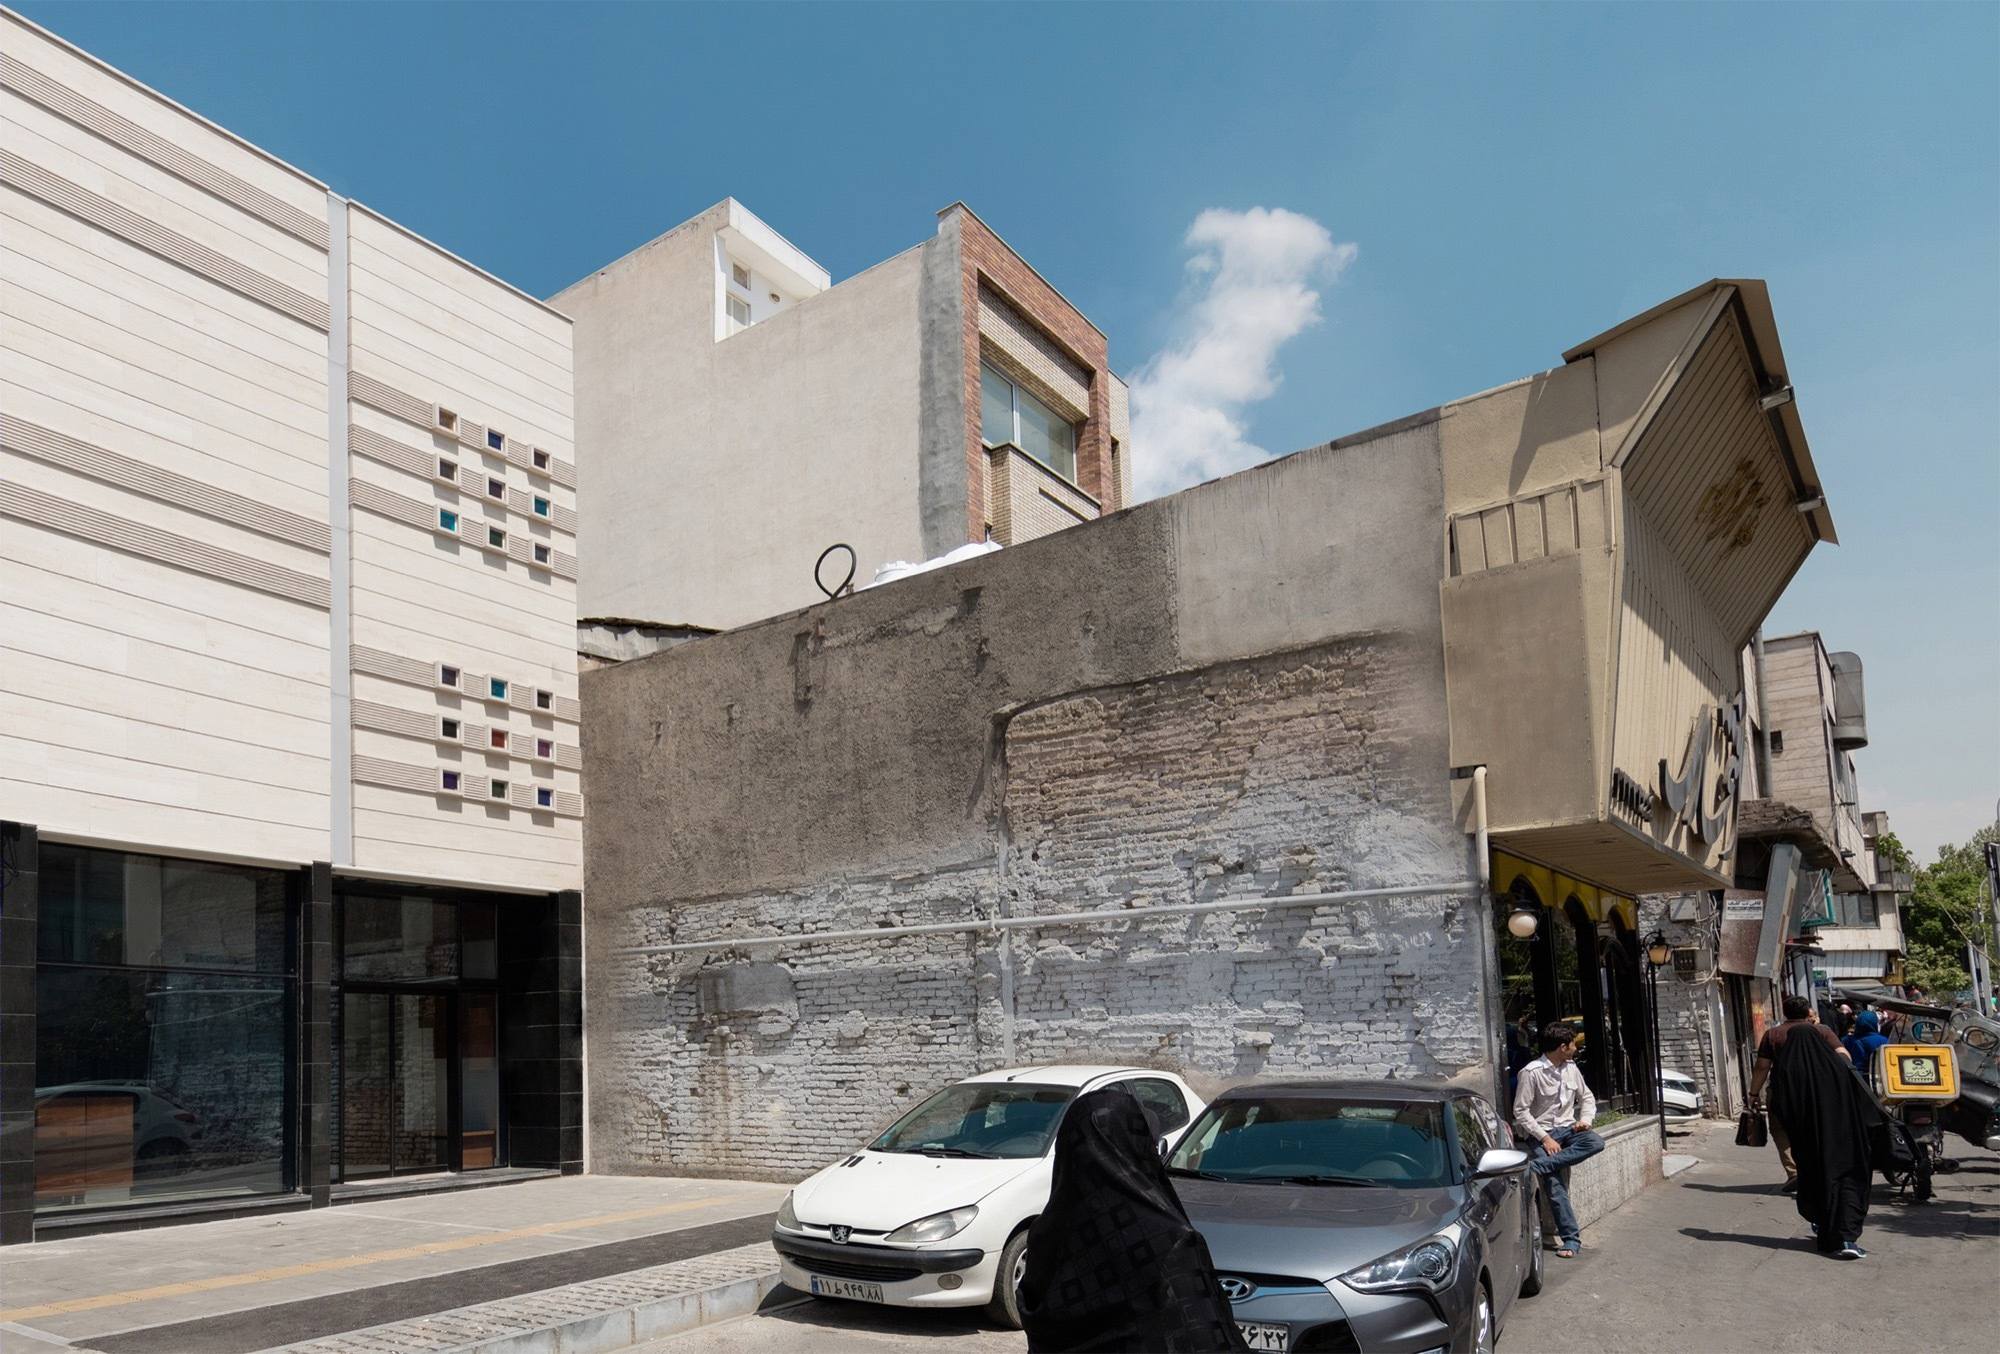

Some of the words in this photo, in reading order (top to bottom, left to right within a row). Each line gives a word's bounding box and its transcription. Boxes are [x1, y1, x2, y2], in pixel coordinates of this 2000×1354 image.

[819, 1279, 831, 1294] ۱۱
[834, 1281, 842, 1295] ط
[843, 1283, 865, 1299] ۹۴۹
[867, 1288, 880, 1301] ۸۸
[1263, 1330, 1287, 1350] ۲۲
